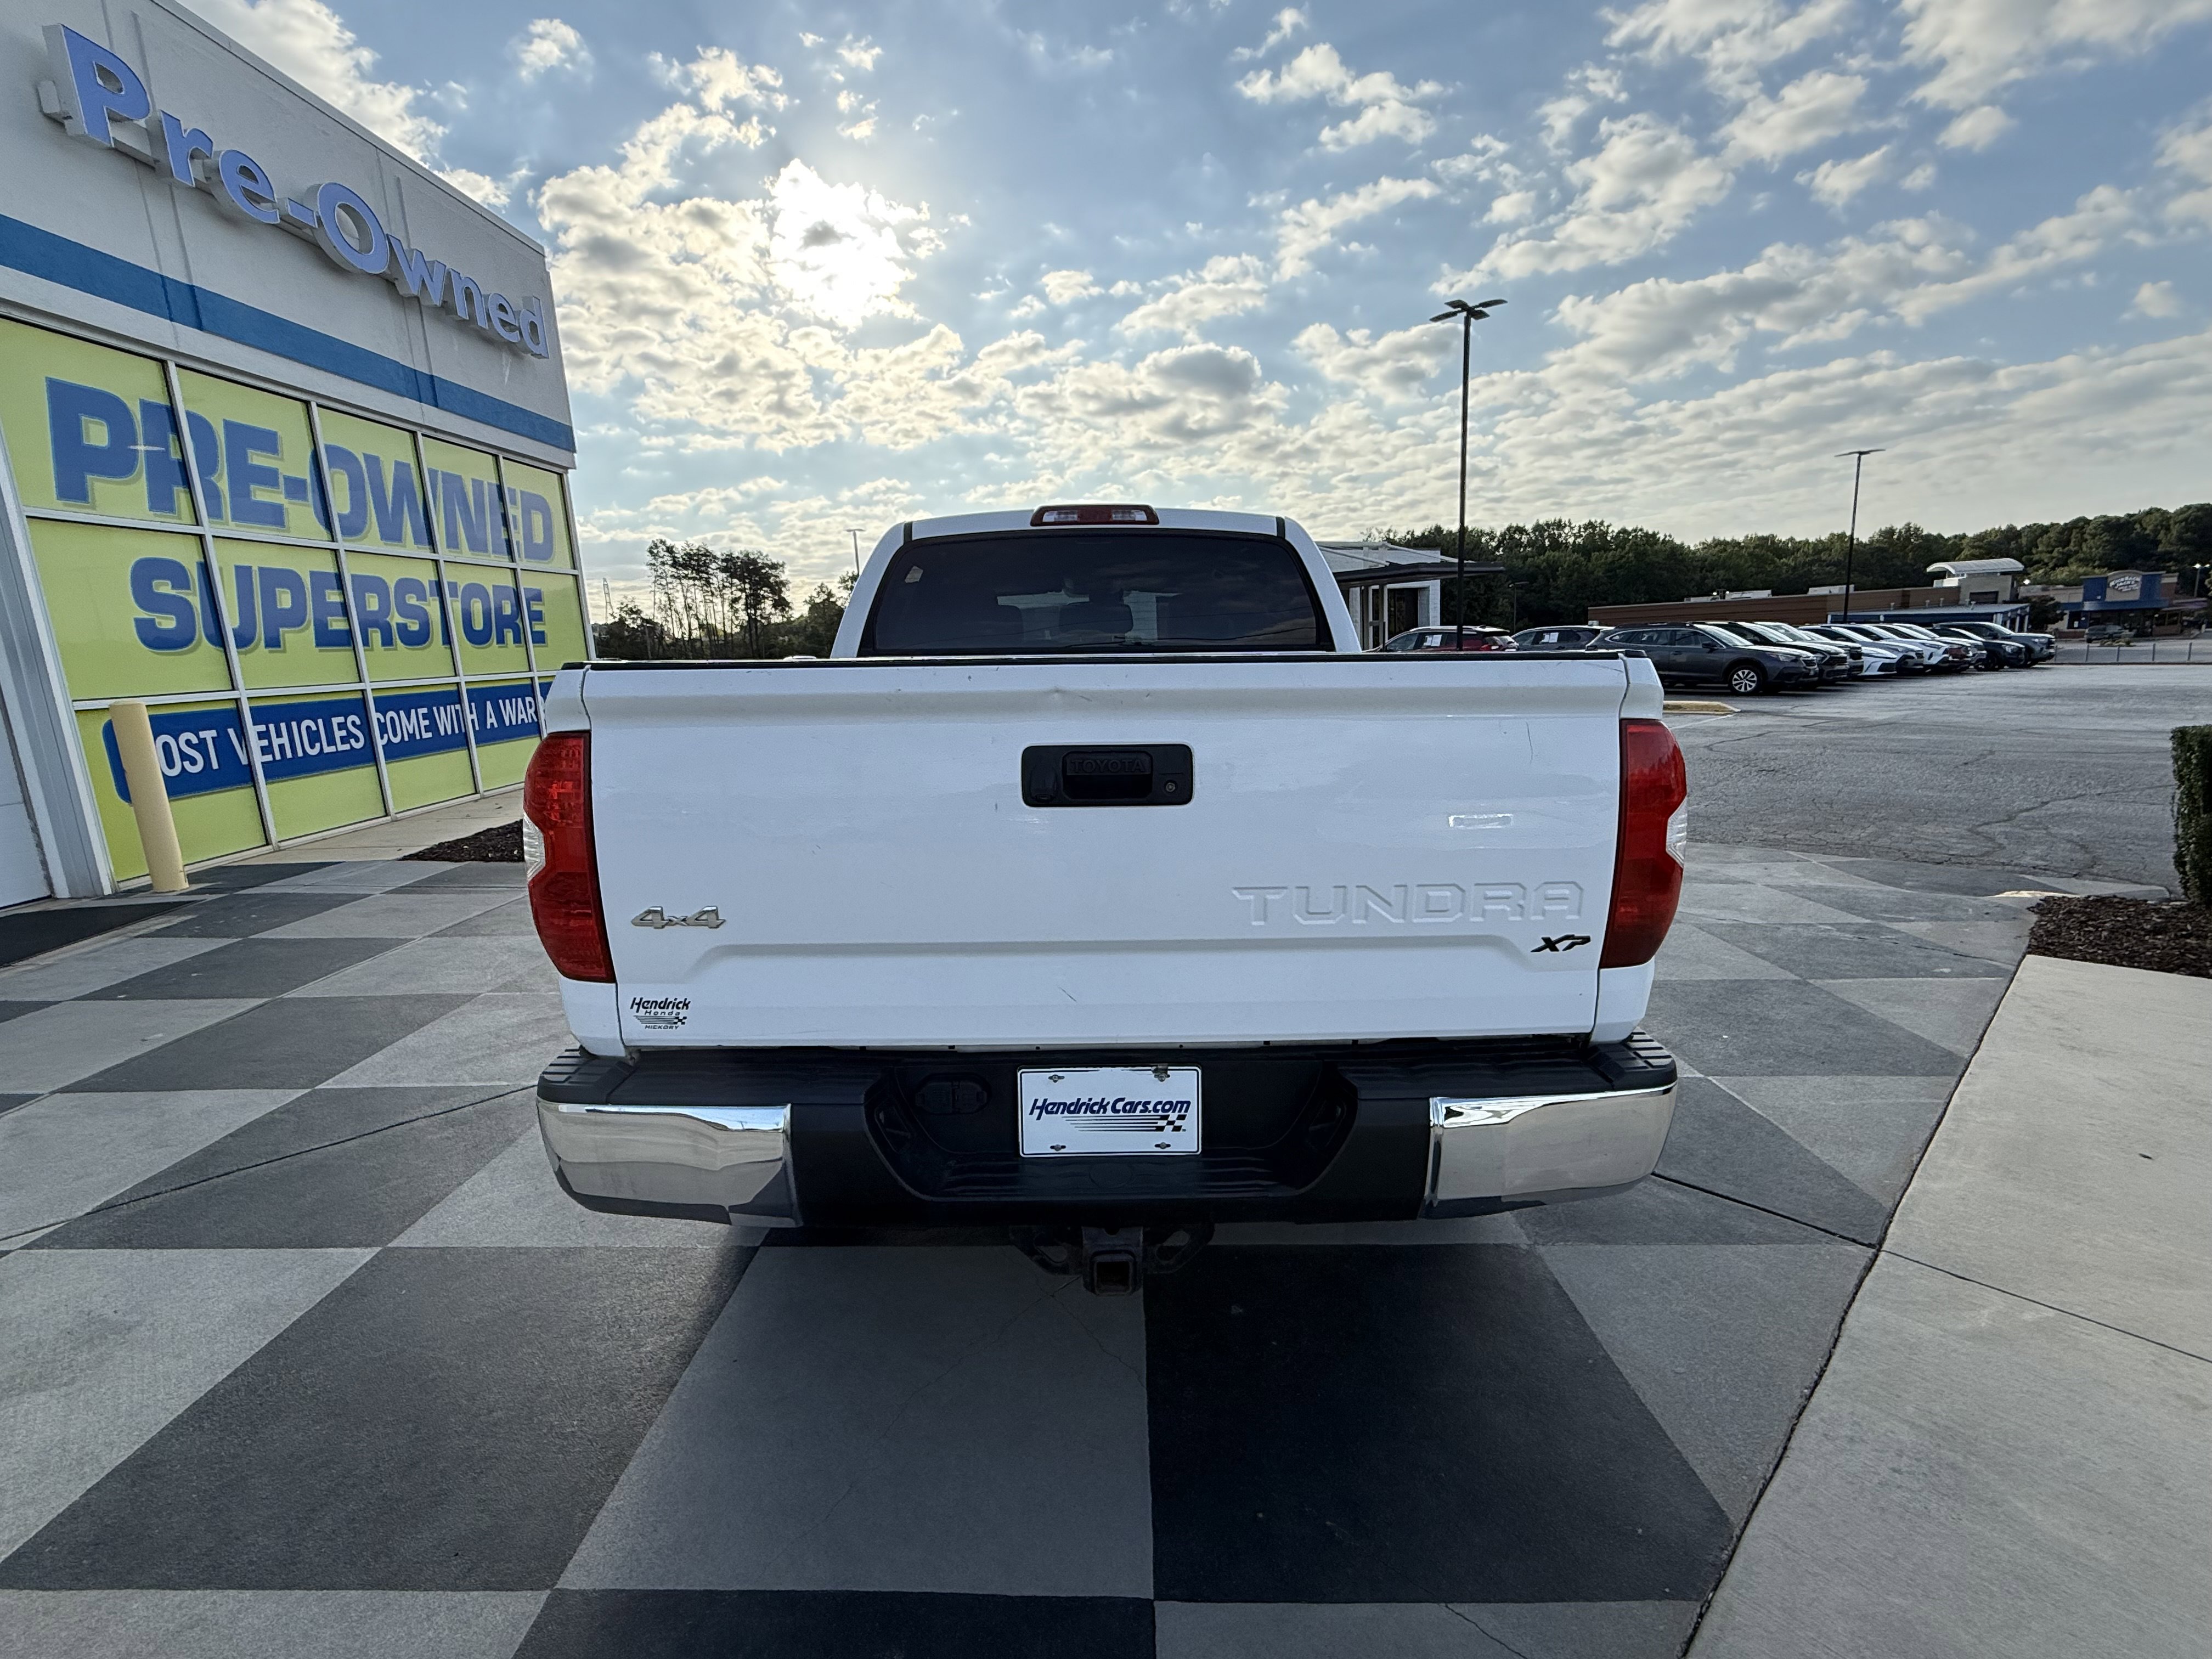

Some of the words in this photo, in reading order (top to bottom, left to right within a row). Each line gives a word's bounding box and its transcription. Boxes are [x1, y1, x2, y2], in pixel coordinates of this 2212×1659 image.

[59, 24, 549, 359] Pre-Owned
[46, 376, 553, 562] PRE-OWNED
[130, 557, 546, 651] SUPERSTORE
[155, 729, 219, 777] OST
[227, 714, 365, 765] VEHICLES
[486, 701, 498, 730] A
[1070, 758, 1146, 774] TOYOTA
[1231, 881, 1584, 926] TUNDRA
[1530, 934, 1591, 952] XP
[630, 997, 691, 1013] Hendrick
